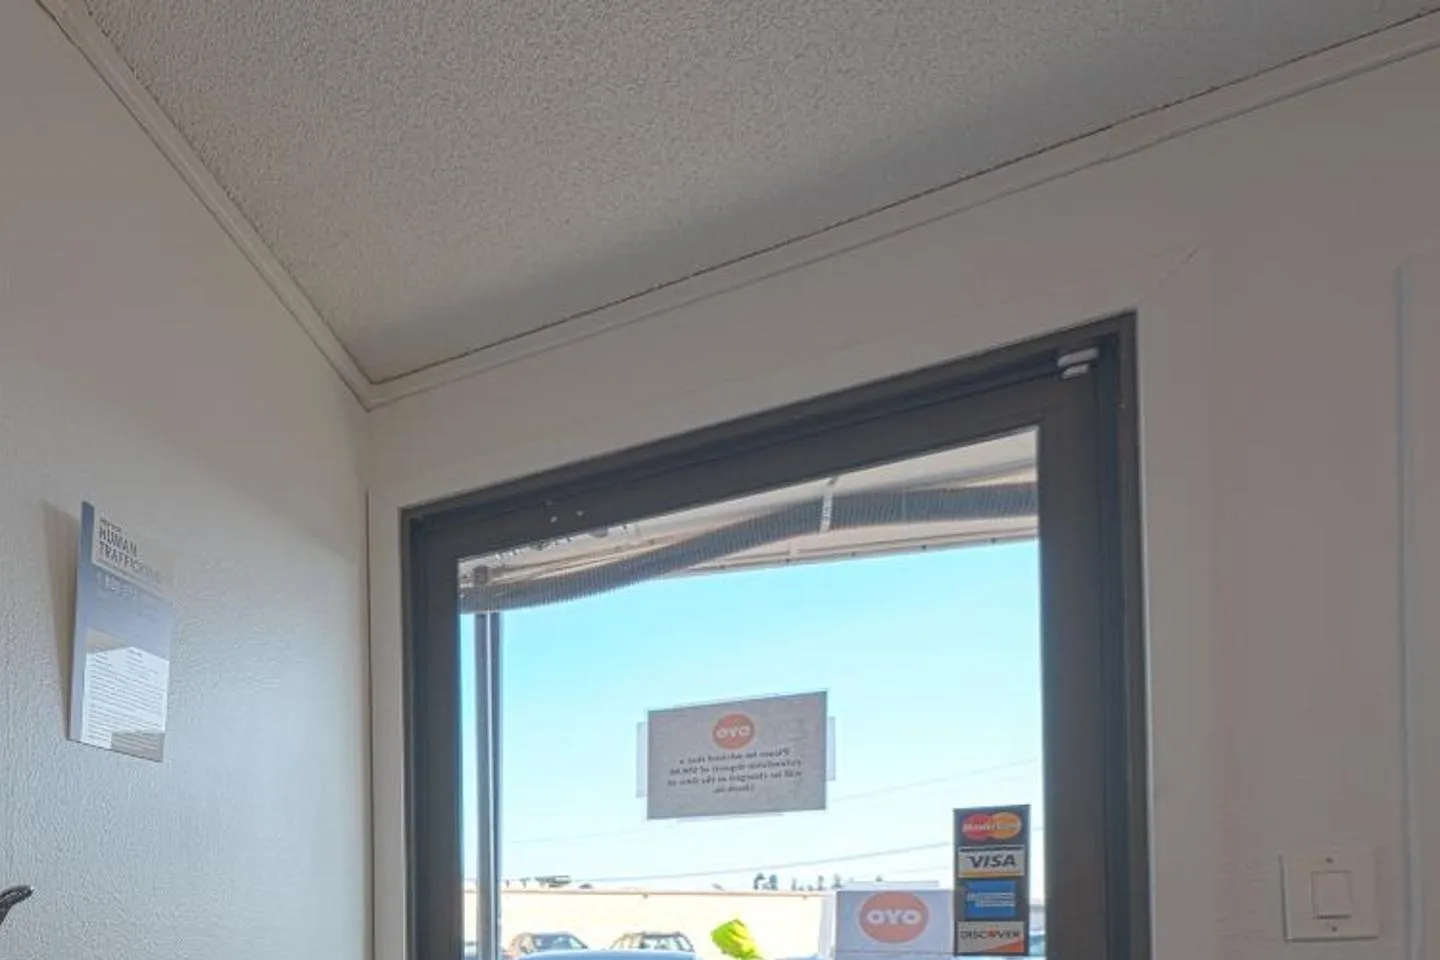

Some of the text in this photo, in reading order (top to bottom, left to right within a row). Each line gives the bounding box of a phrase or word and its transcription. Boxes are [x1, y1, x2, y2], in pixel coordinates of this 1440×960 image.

[715, 725, 751, 740] OYO
[968, 853, 1018, 869] VISA
[866, 908, 922, 926] OYO
[959, 927, 1022, 941] DISCOVER
